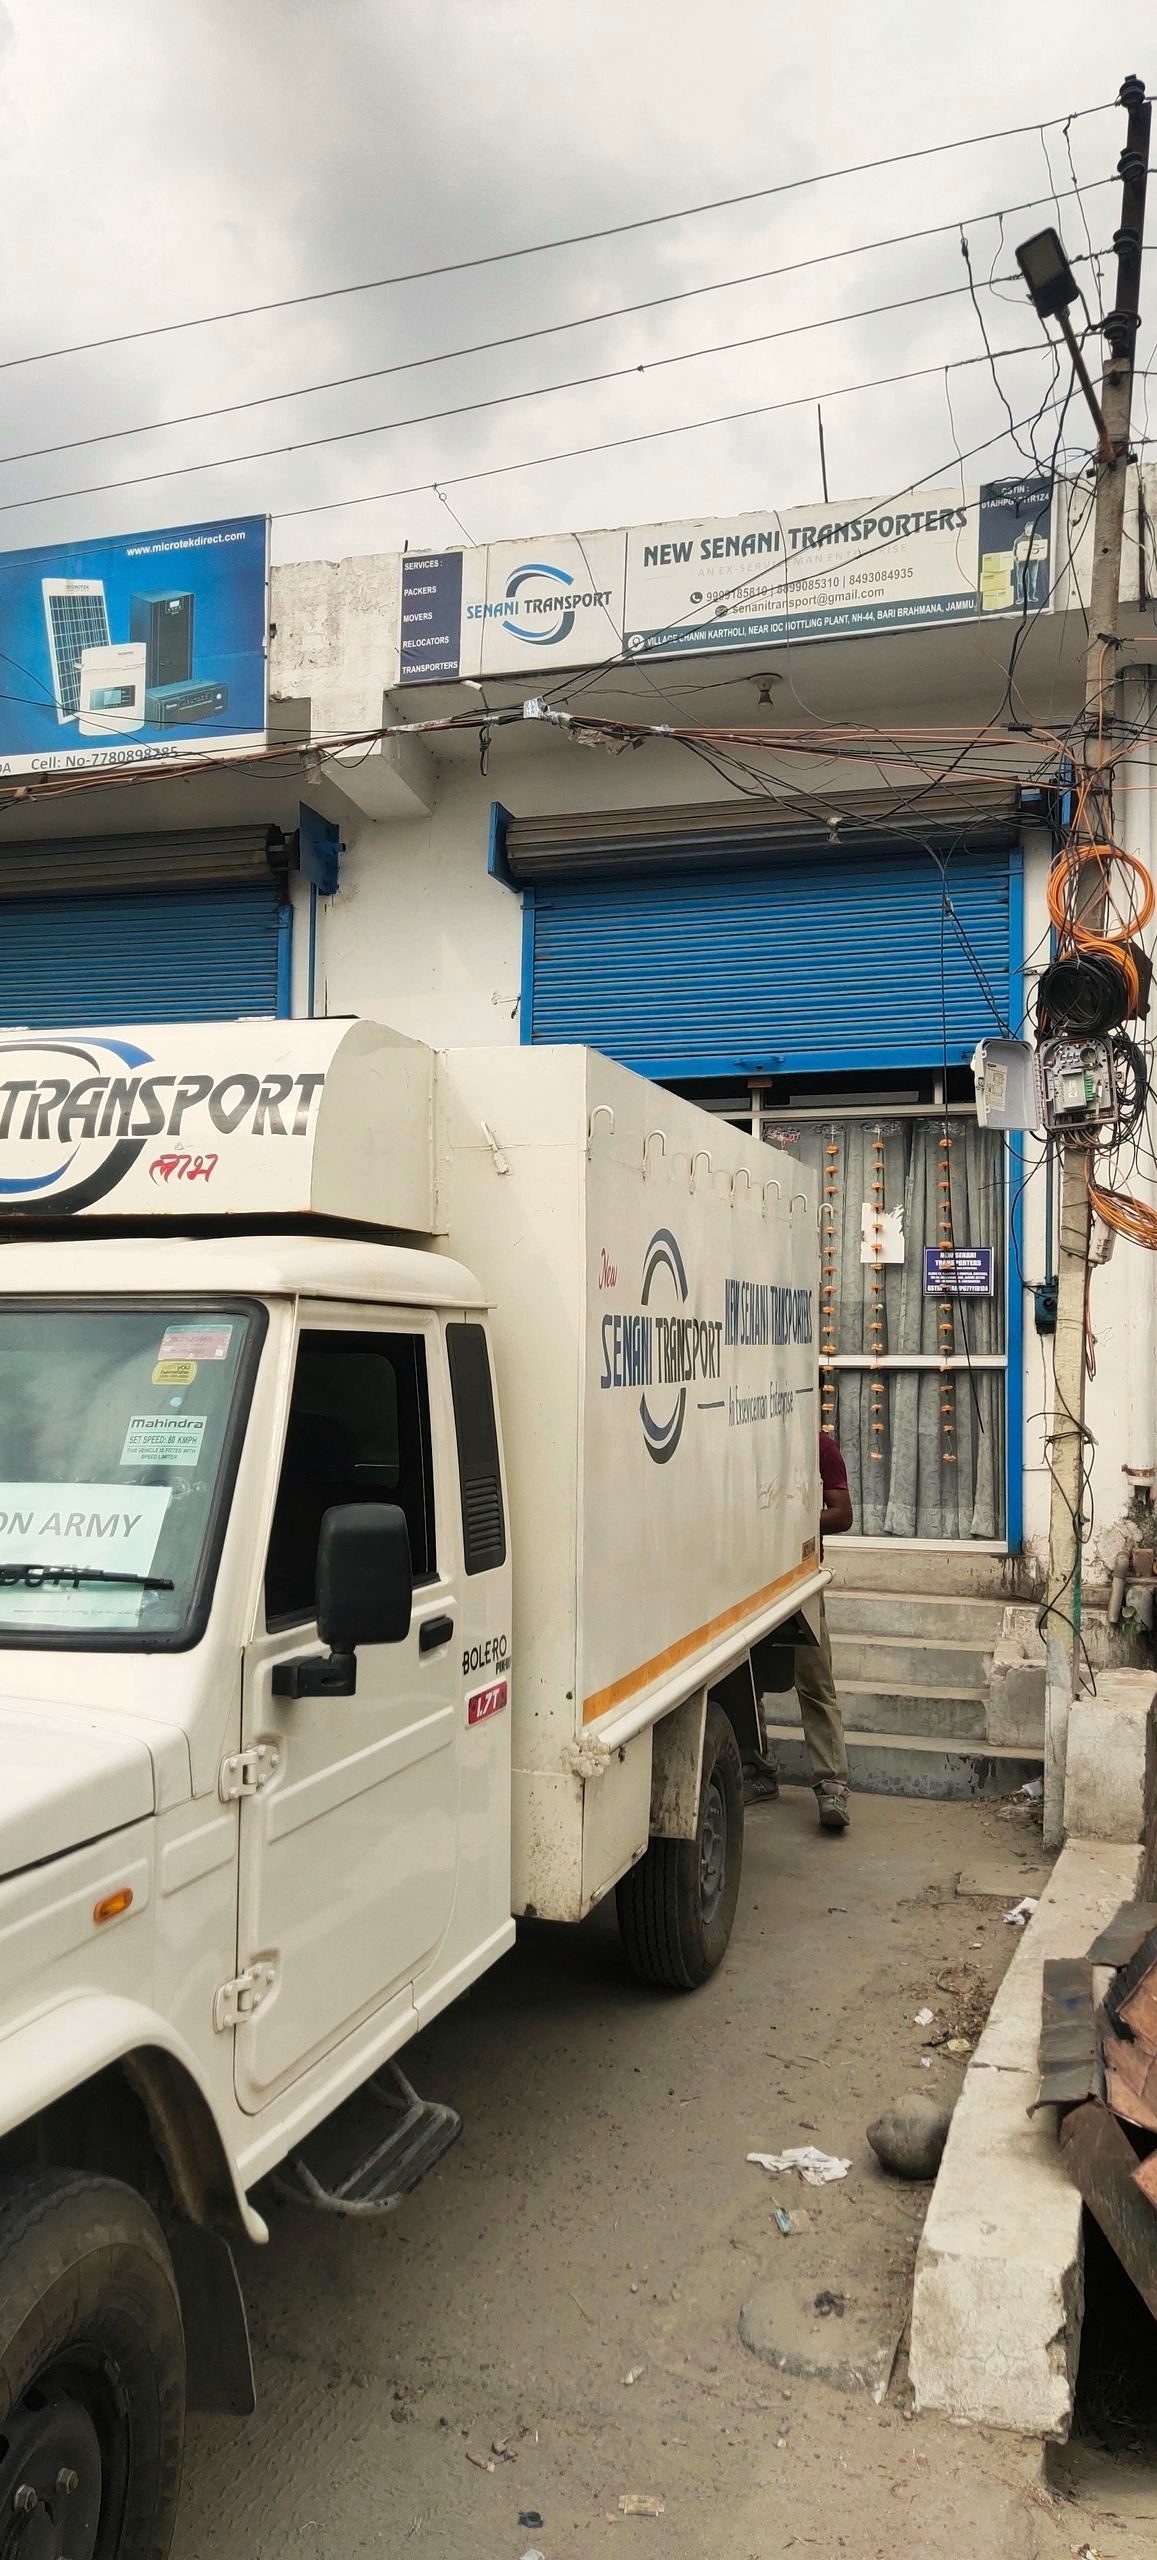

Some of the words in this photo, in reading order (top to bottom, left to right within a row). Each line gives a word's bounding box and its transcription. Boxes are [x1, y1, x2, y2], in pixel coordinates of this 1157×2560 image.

[127, 532, 246, 556] www.microtekdirect.com
[644, 541, 694, 567] NEW
[700, 531, 780, 560] SENANI
[788, 506, 968, 550] TRANSPORTERS
[404, 560, 439, 571] SERVICES
[849, 567, 913, 585] 8493084935
[404, 585, 437, 597] PACKERS
[732, 587, 885, 614] senanitransport@gmail.com
[403, 612, 433, 623] MOVERS
[467, 601, 519, 619] SENANI
[524, 591, 612, 614] TRANSPORT
[707, 627, 747, 639] KARTHOLI,
[748, 624, 769, 635] NEAR
[770, 622, 784, 633] IOC
[824, 614, 851, 627] PLANT,
[852, 612, 876, 624] NH-44,
[877, 608, 896, 620] BARI
[897, 603, 944, 616] BRAHMANA,
[402, 636, 450, 648] RELOCATORS
[402, 661, 458, 674] TRANSPORTERS
[31, 756, 61, 770] Cell:
[0, 1073, 325, 1143] TRANSPORT
[599, 1247, 617, 1290] New
[725, 1278, 740, 1346] NEW
[741, 1280, 769, 1346] SENANI
[770, 1285, 813, 1346] TRANSPORTERS
[601, 1314, 652, 1389] SENANI
[655, 1316, 722, 1384] TRANSPORT
[131, 1418, 204, 1428] Mahindra
[129, 1435, 142, 1444] SET
[143, 1435, 166, 1444] SPEED:
[167, 1435, 176, 1444] 80
[177, 1435, 198, 1444] KMPH
[38, 1512, 143, 1538] ARMY
[462, 1634, 507, 1676] BOLERO
[476, 1688, 500, 1718] 1.7T
